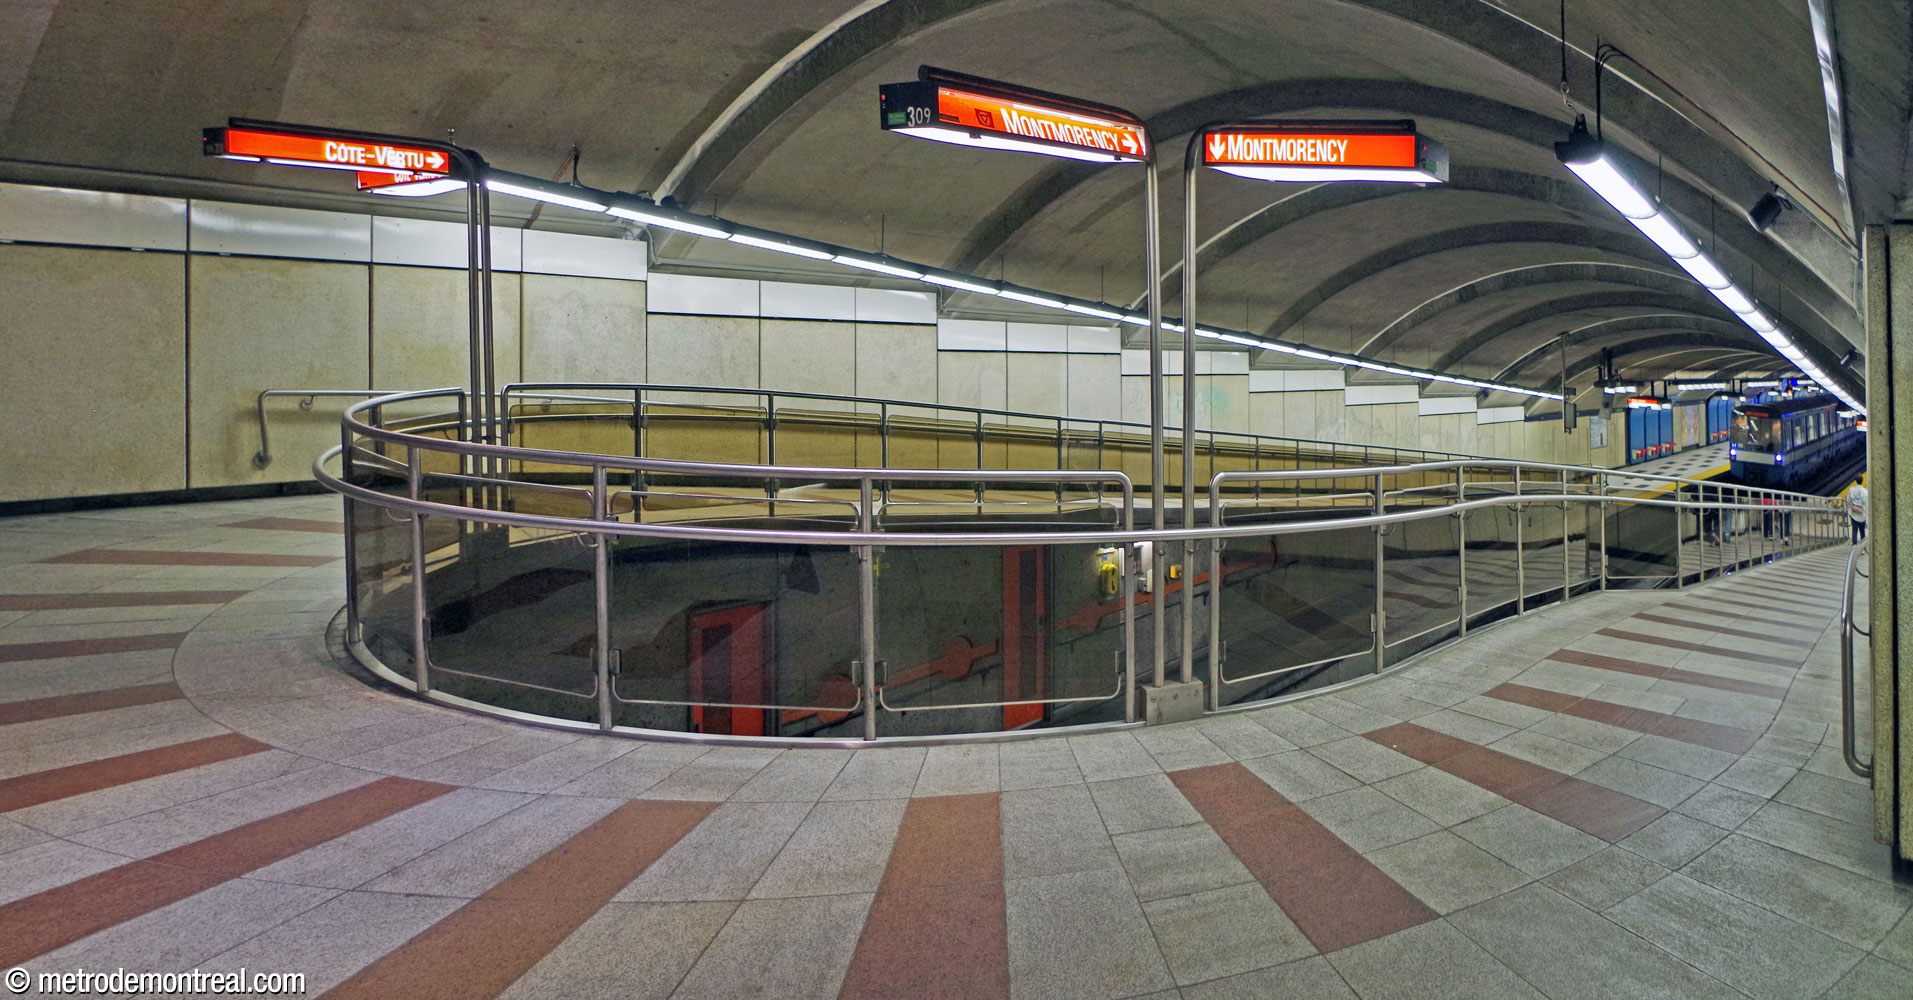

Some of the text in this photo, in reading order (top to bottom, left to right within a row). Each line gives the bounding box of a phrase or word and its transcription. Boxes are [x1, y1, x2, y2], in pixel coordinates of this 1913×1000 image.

[907, 106, 931, 127] 309
[1000, 108, 1120, 151] MONTMORENCY
[1227, 135, 1347, 162] MONTMORENCY
